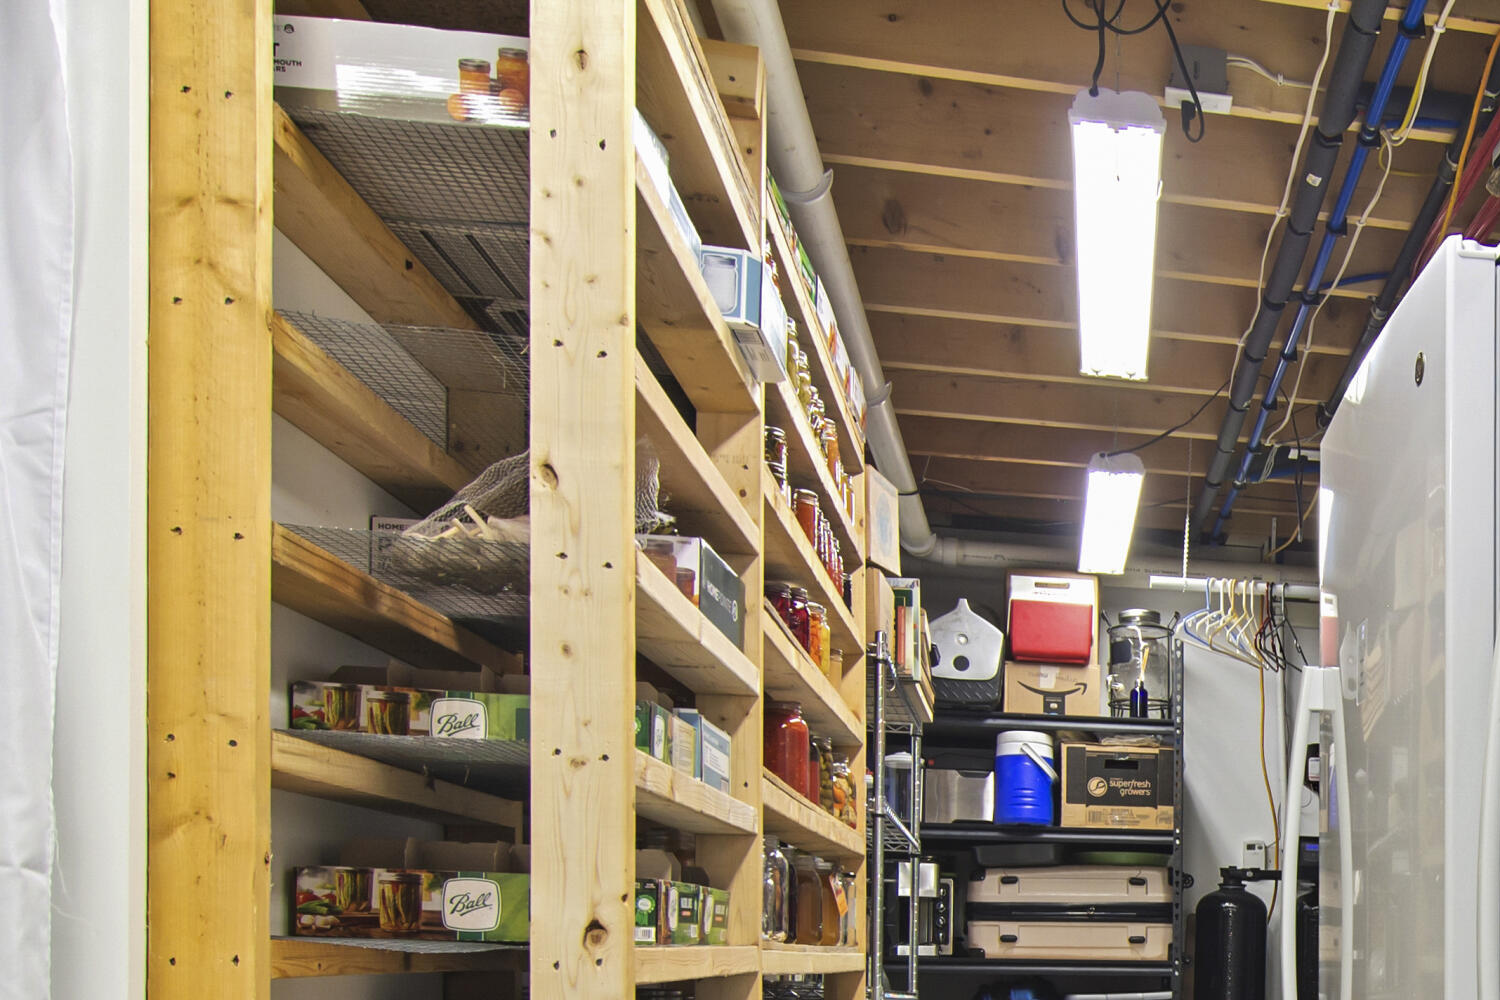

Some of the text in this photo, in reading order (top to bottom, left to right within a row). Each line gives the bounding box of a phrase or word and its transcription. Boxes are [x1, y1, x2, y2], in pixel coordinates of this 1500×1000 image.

[437, 712, 480, 737] Ball
[1109, 779, 1151, 789] superfresh
[1119, 788, 1151, 797] growers
[449, 892, 492, 917] Ball
